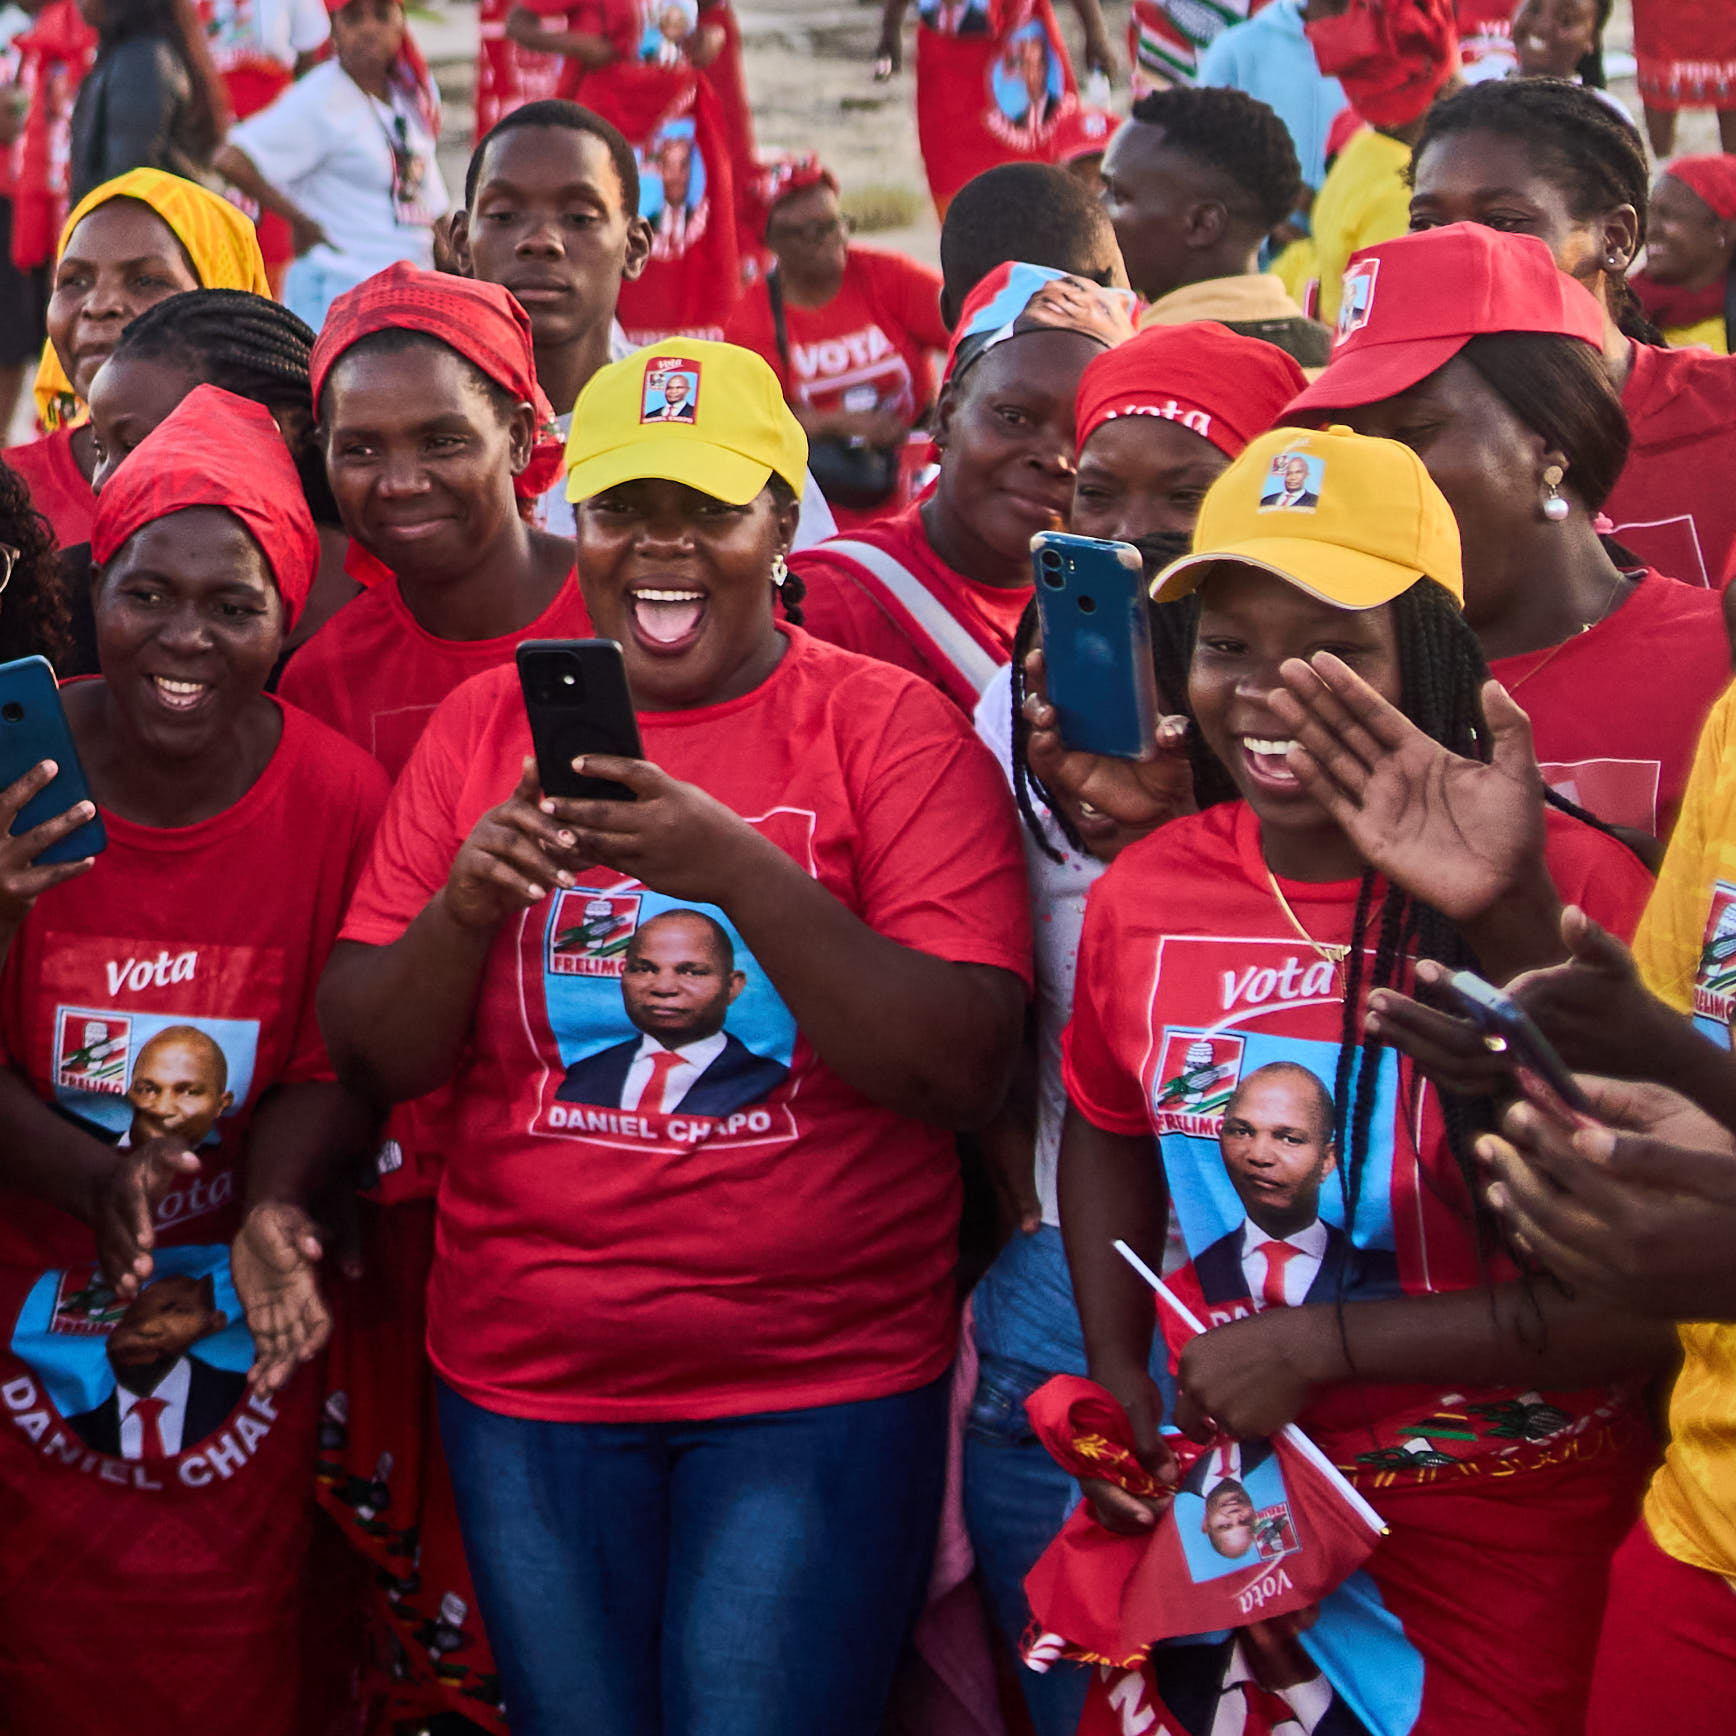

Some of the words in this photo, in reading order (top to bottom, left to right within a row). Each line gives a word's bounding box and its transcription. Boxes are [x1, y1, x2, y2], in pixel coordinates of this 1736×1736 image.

[792, 323, 895, 378] VOTA
[107, 951, 198, 997] Vota
[1221, 957, 1336, 1011] Vota
[549, 1106, 658, 1140] DANIEL
[157, 1171, 233, 1220] ota
[0, 1374, 163, 1490] DANIEL
[1239, 1568, 1294, 1614] Vota
